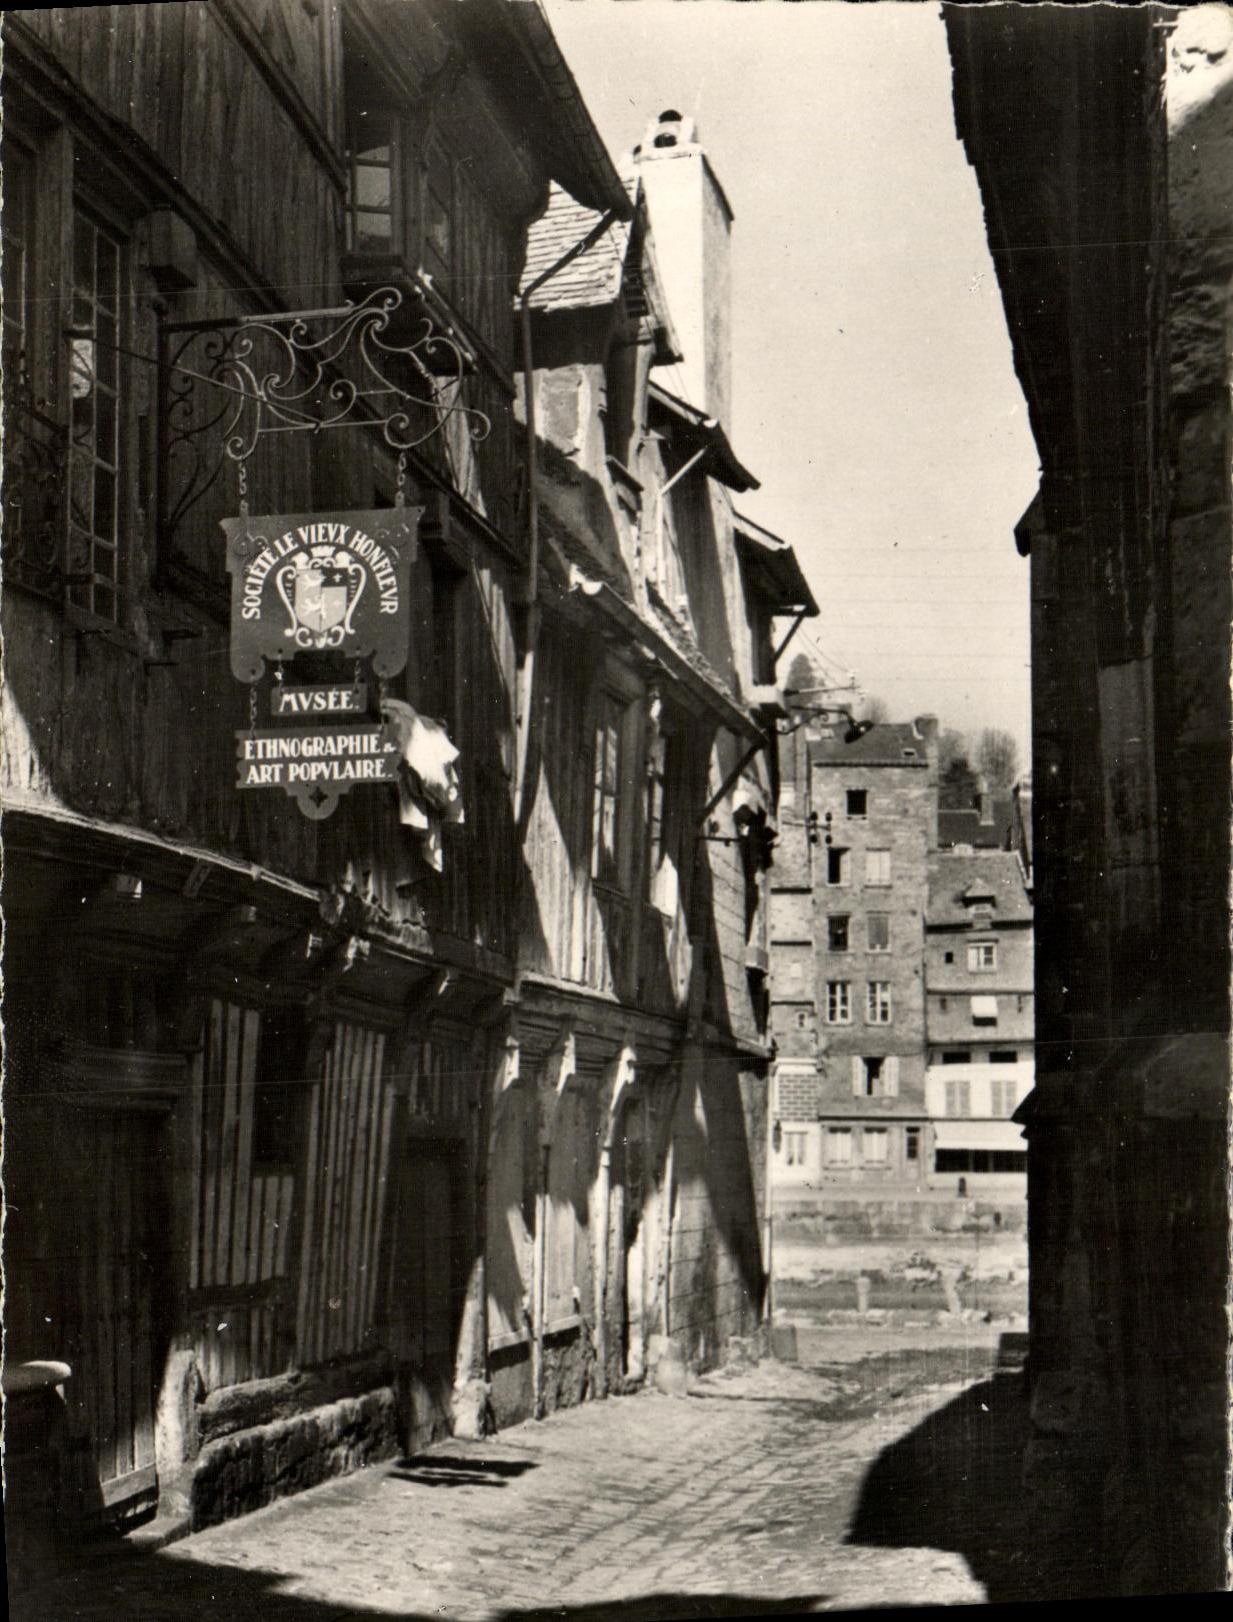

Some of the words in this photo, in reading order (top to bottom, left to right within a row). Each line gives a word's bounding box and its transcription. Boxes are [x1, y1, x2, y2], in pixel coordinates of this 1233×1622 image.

[273, 531, 299, 557] LE
[244, 733, 381, 760] ETHNOGRAPHIE
[246, 763, 284, 784] ART
